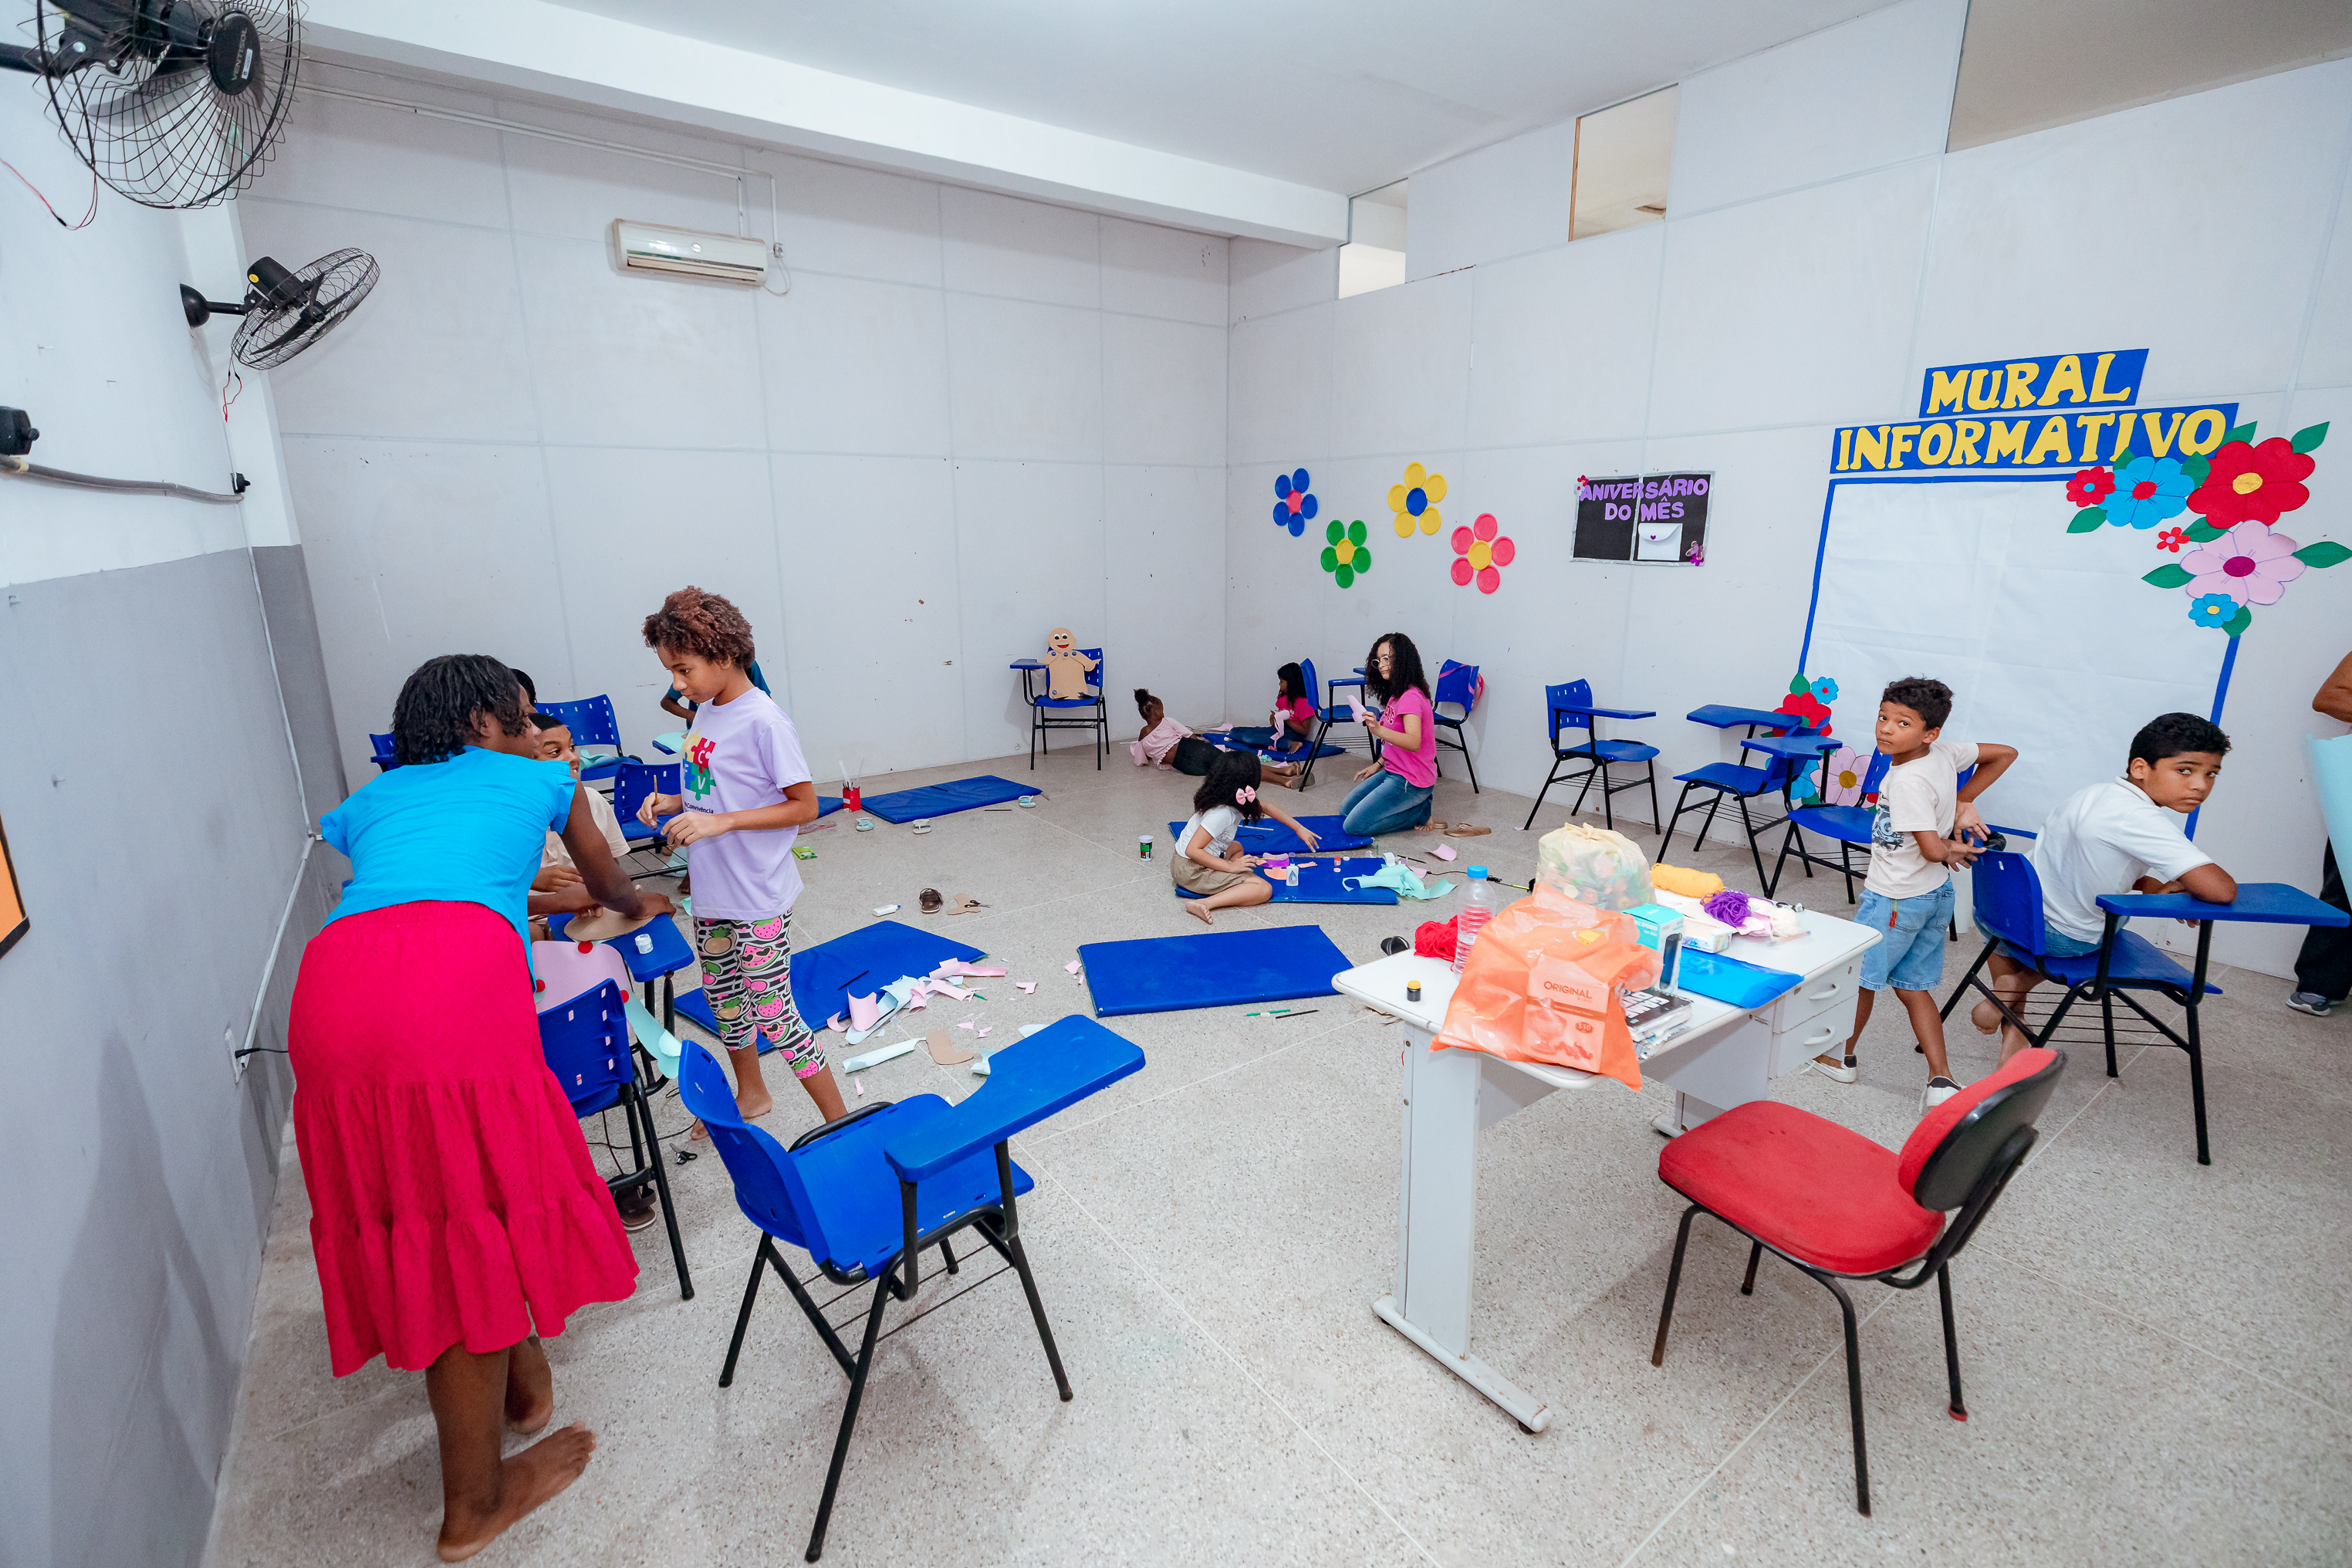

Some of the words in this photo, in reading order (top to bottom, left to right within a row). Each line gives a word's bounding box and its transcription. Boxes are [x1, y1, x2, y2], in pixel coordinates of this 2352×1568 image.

[231, 28, 248, 81] VENTISOL
[1926, 353, 2132, 415] MURAL
[1835, 408, 2226, 471] INFORMATIVO
[1579, 475, 1708, 502] ANIVERSÁRIO
[1604, 502, 1632, 521] DO
[1641, 495, 1685, 522] MÊS
[1543, 981, 1593, 999] ORIGINAL
